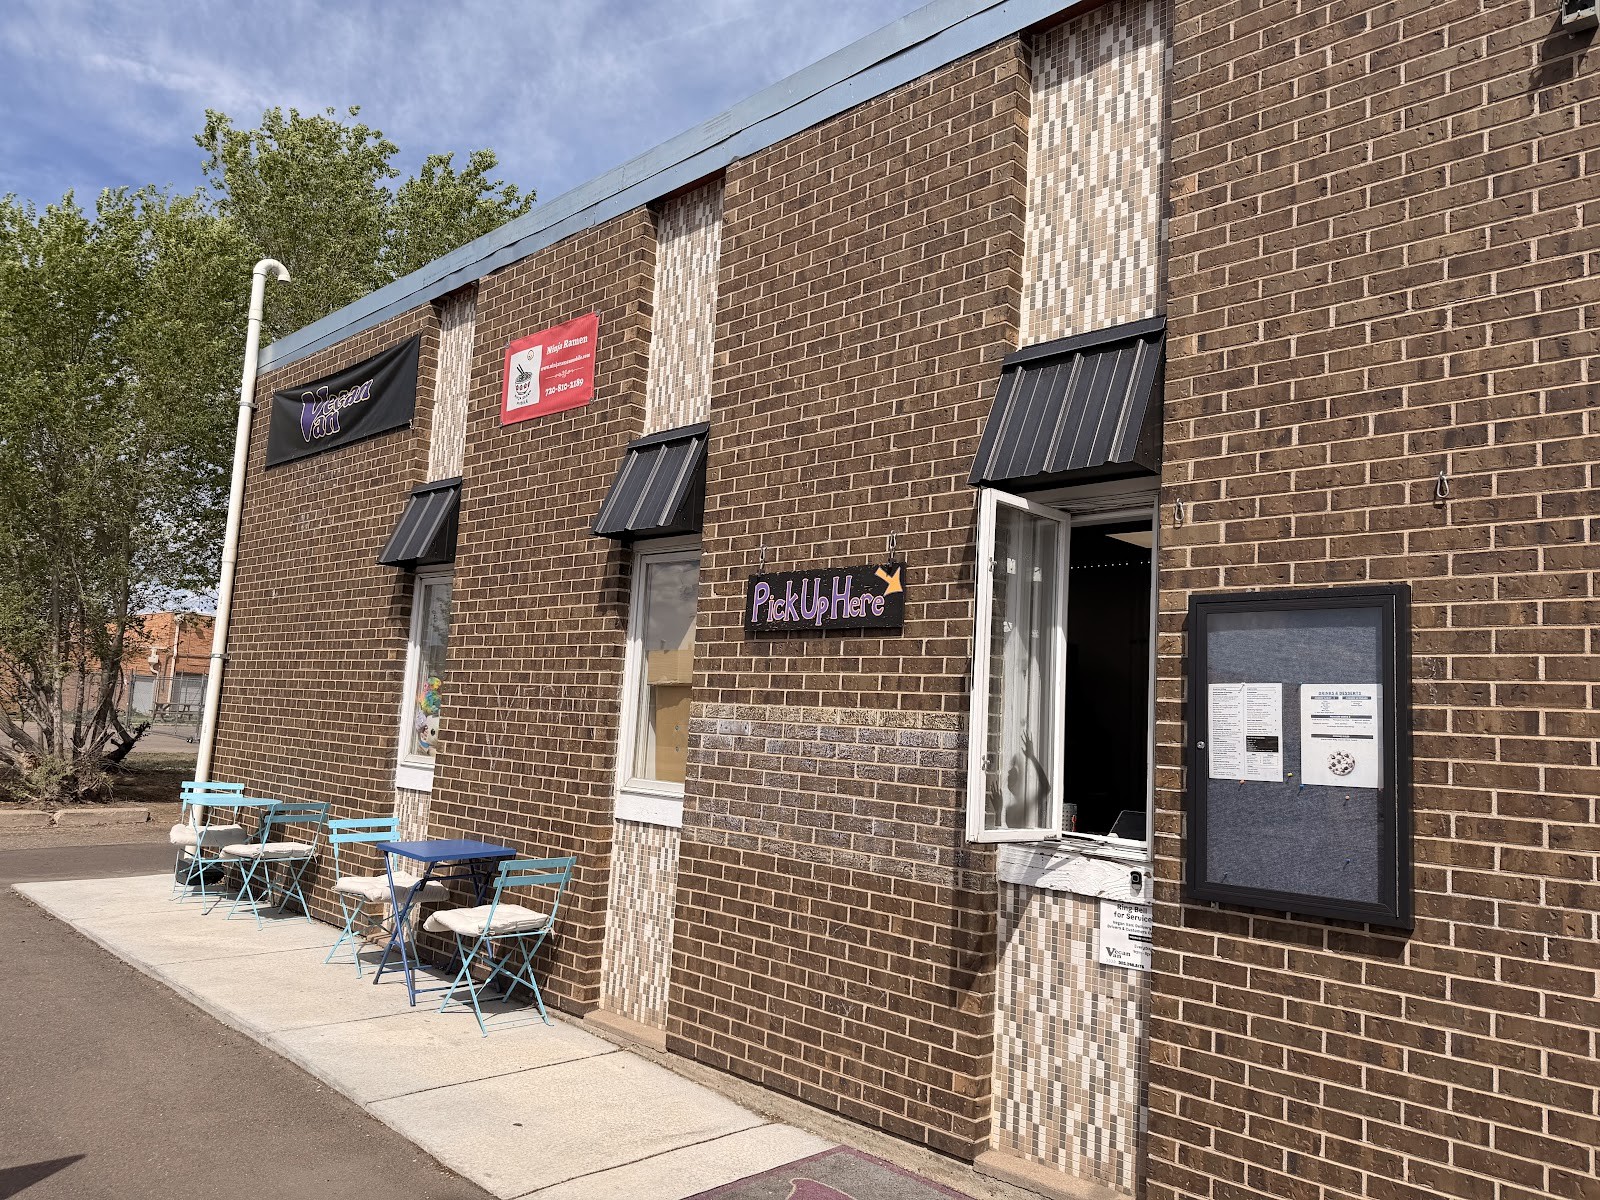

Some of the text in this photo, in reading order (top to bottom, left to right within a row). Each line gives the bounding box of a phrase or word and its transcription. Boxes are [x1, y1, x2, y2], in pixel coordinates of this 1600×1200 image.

[563, 336, 588, 349] Ramen
[751, 575, 885, 626] Pick Up Here
[1117, 903, 1132, 913] Ring
[1126, 913, 1152, 923] Service
